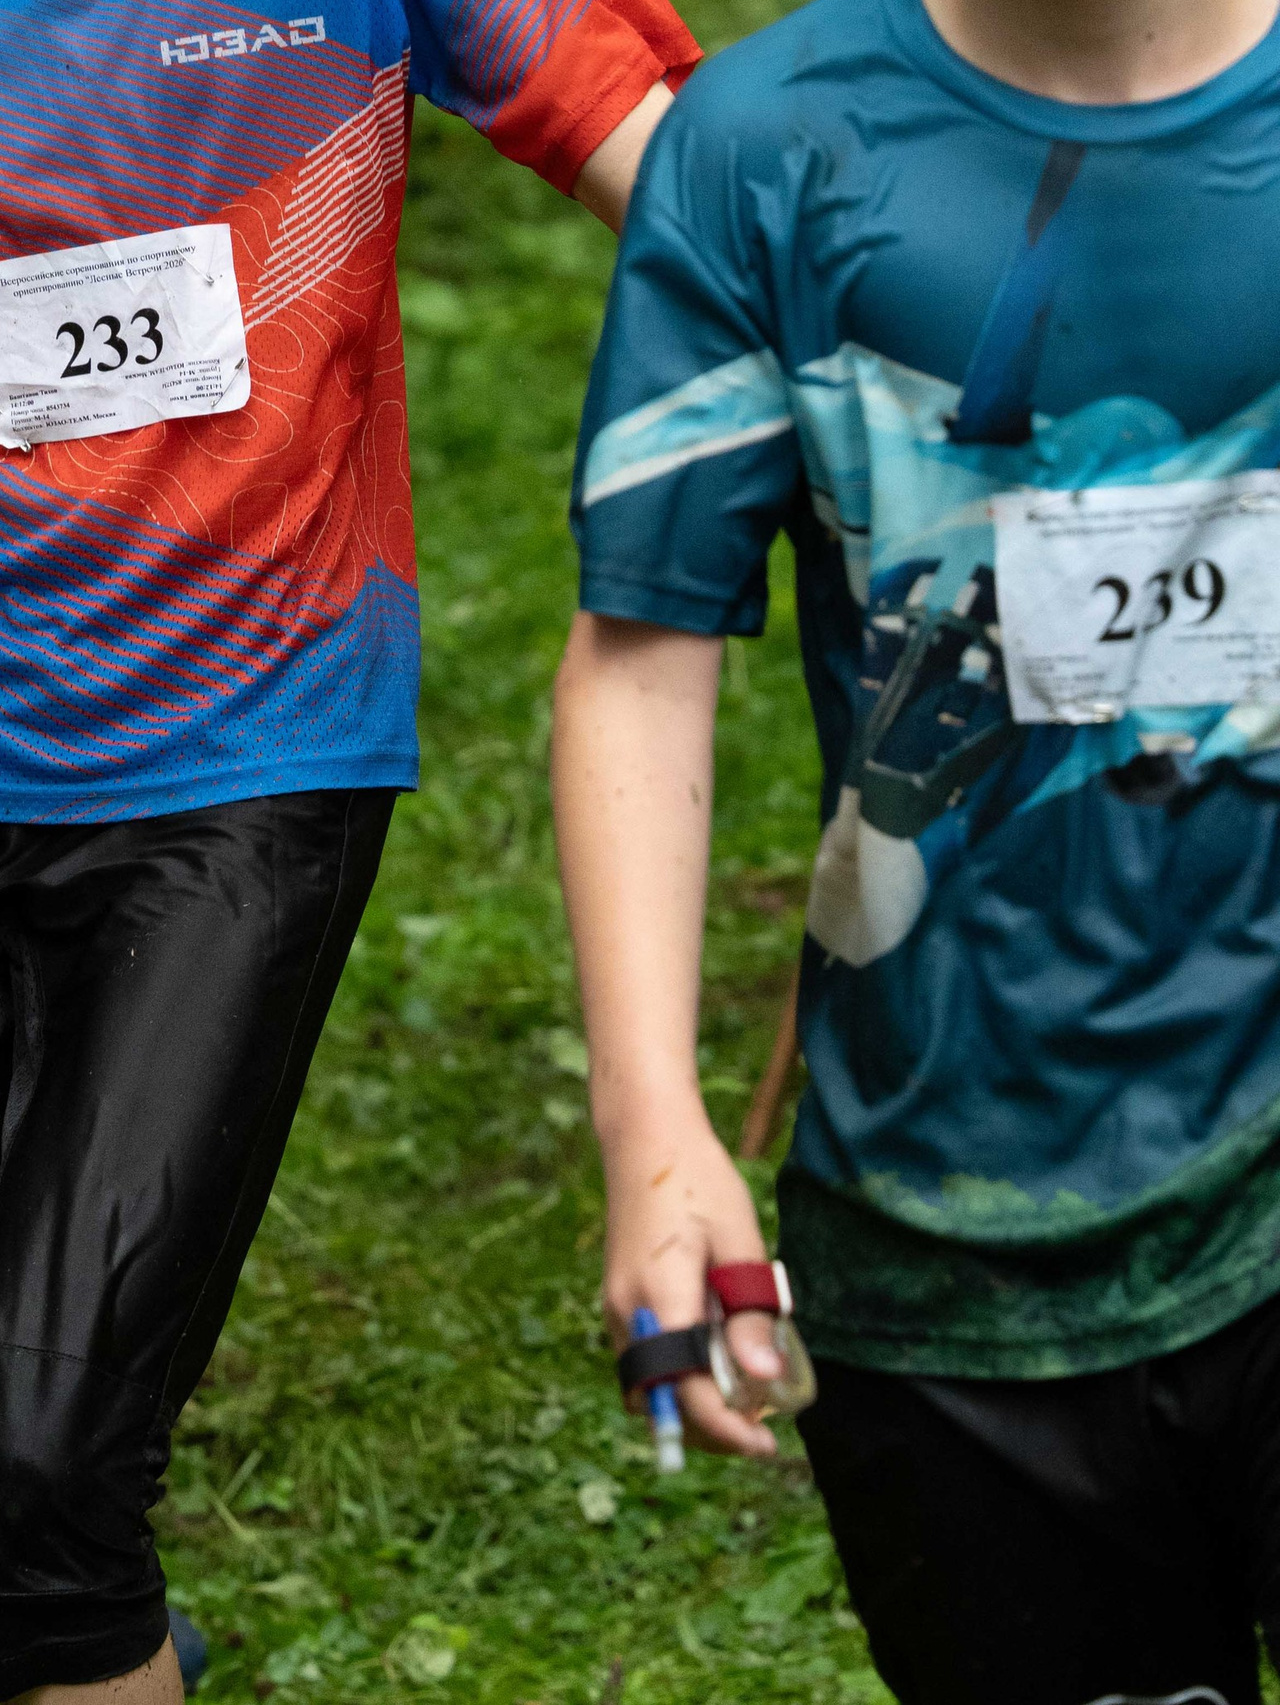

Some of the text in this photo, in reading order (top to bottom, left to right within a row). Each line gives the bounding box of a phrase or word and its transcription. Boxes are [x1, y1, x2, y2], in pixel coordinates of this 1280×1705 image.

[159, 14, 326, 67] ЮЗАО
[0, 269, 64, 287] Всероссийские
[65, 259, 125, 275] соревнования
[126, 256, 139, 265] по
[13, 279, 84, 298] ориентированию
[125, 264, 163, 278] Встречи
[56, 307, 164, 379] 233
[1092, 557, 1225, 643] 239
